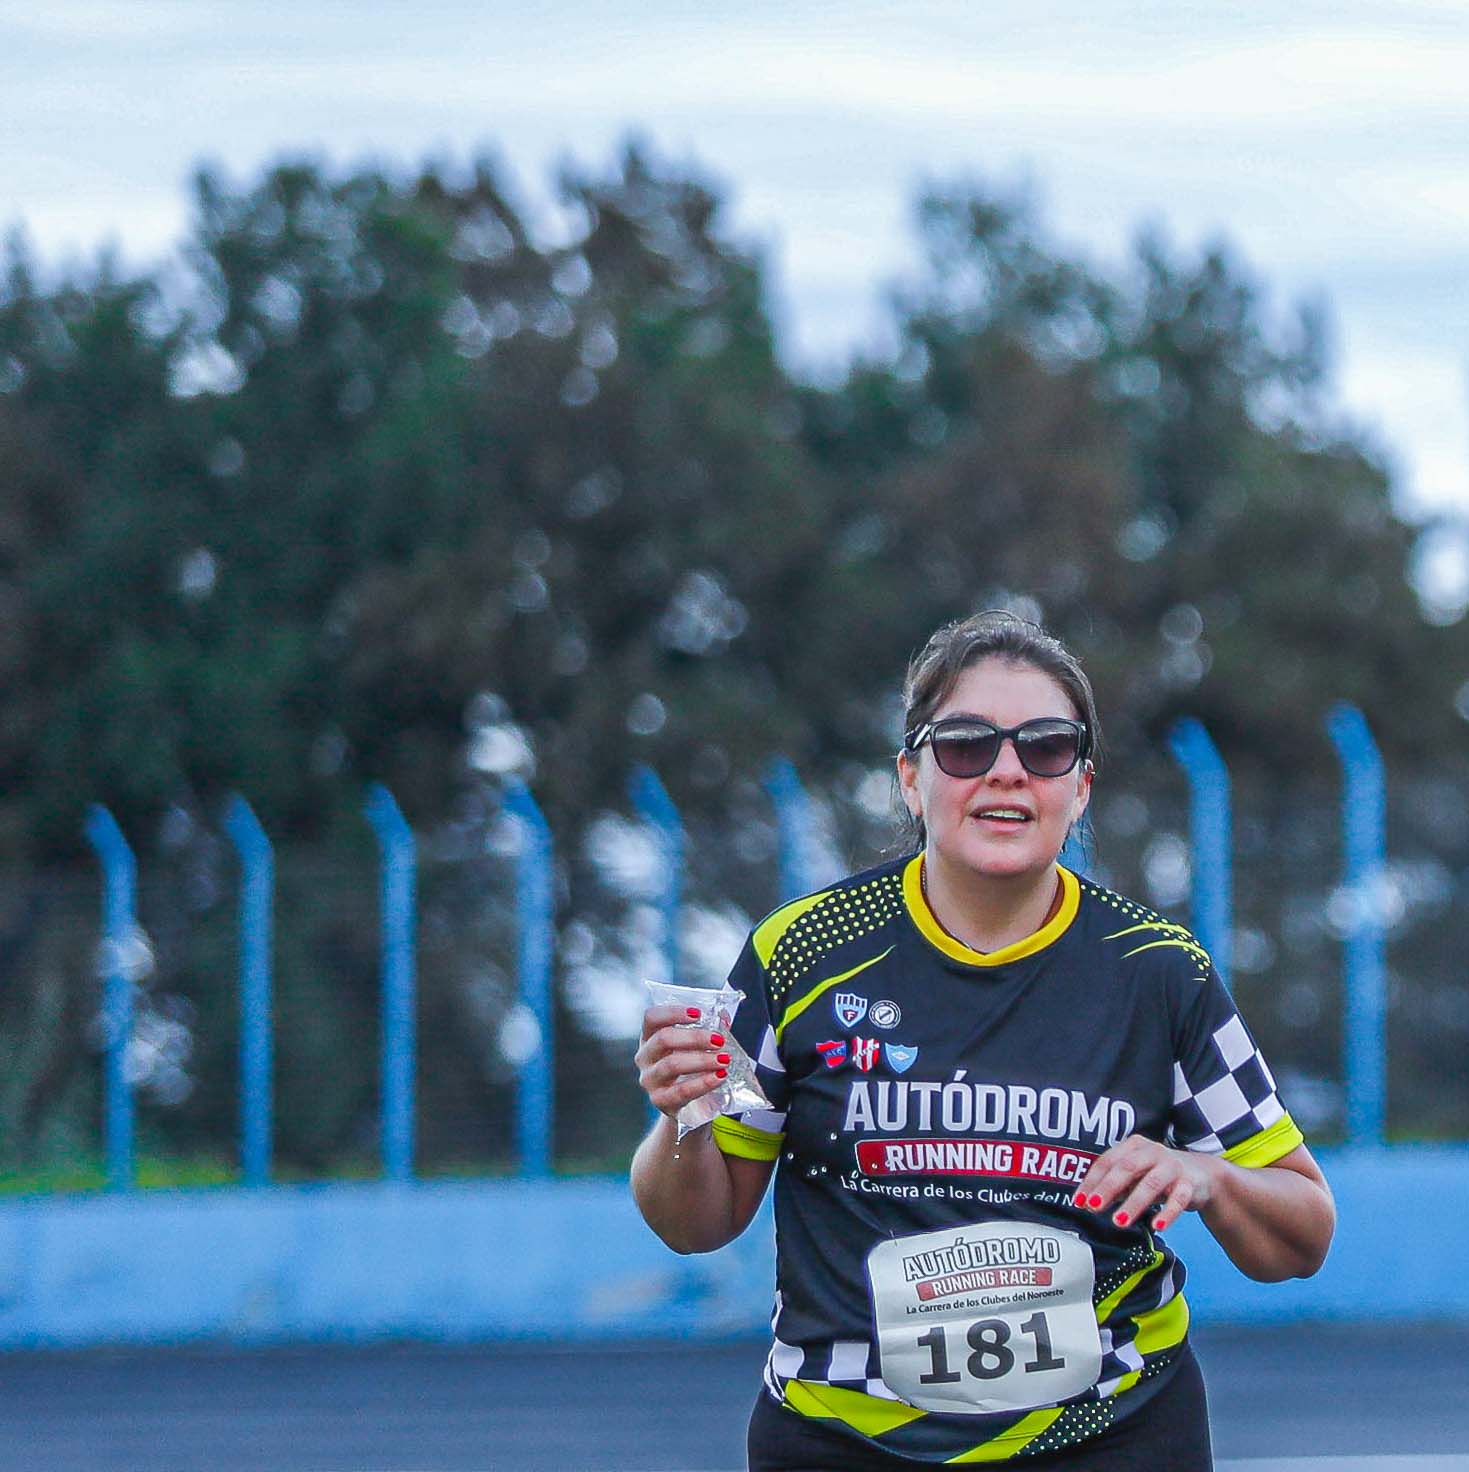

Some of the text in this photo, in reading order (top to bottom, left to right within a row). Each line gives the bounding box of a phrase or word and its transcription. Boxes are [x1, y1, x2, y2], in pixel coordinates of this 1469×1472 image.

[843, 1069, 1135, 1147] AUTÓDROMO
[885, 1143, 1092, 1183] RUNNING RACE
[840, 1174, 858, 1191] La
[860, 1178, 919, 1198] Carrera
[923, 1183, 945, 1198] de
[949, 1185, 973, 1200] los
[977, 1188, 1030, 1204] Clubes
[1034, 1190, 1060, 1204] del
[902, 1237, 1061, 1282] AUTÓDROMO
[906, 1288, 1065, 1315] La Carrera de los Clubes del Noroeste
[932, 1269, 1037, 1297] RUNNING RACE
[917, 1311, 1066, 1385] 181
